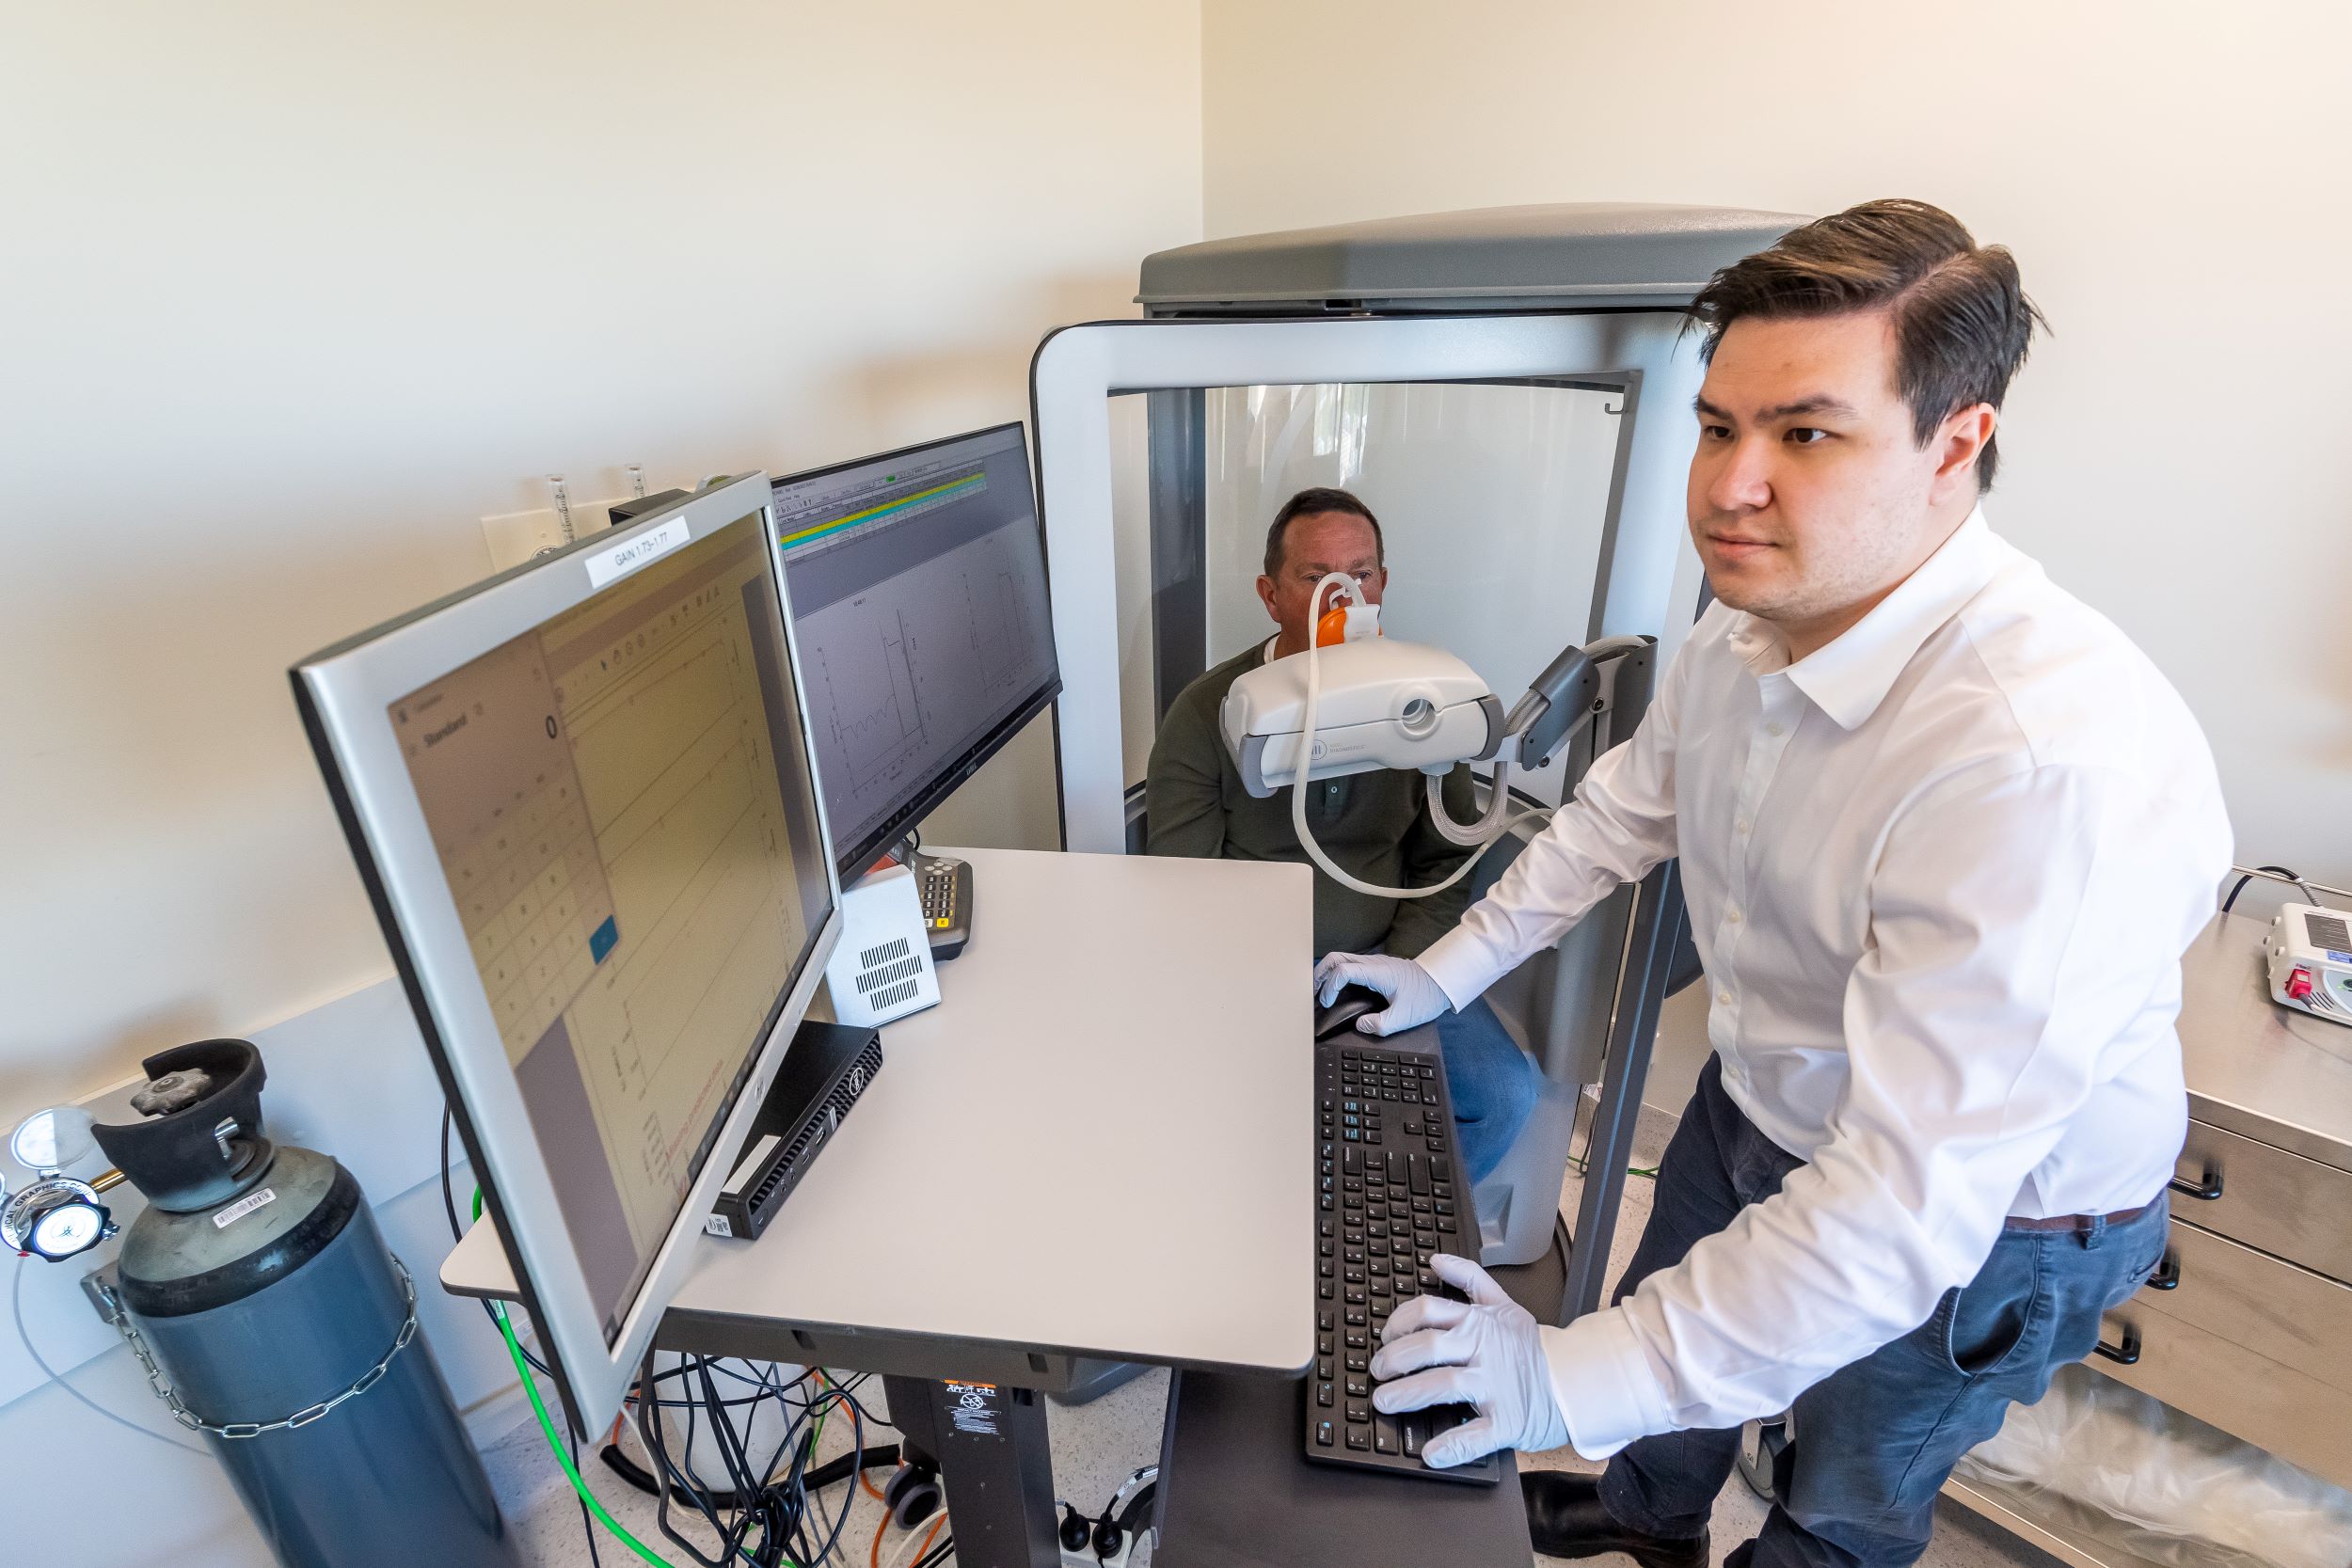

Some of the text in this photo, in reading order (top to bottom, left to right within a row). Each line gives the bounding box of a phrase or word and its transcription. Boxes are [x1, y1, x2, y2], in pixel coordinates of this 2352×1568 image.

[614, 531, 668, 566] GAIN 1.73-1.77
[546, 715, 558, 739] 0
[14, 1181, 67, 1208] GRAPHICS
